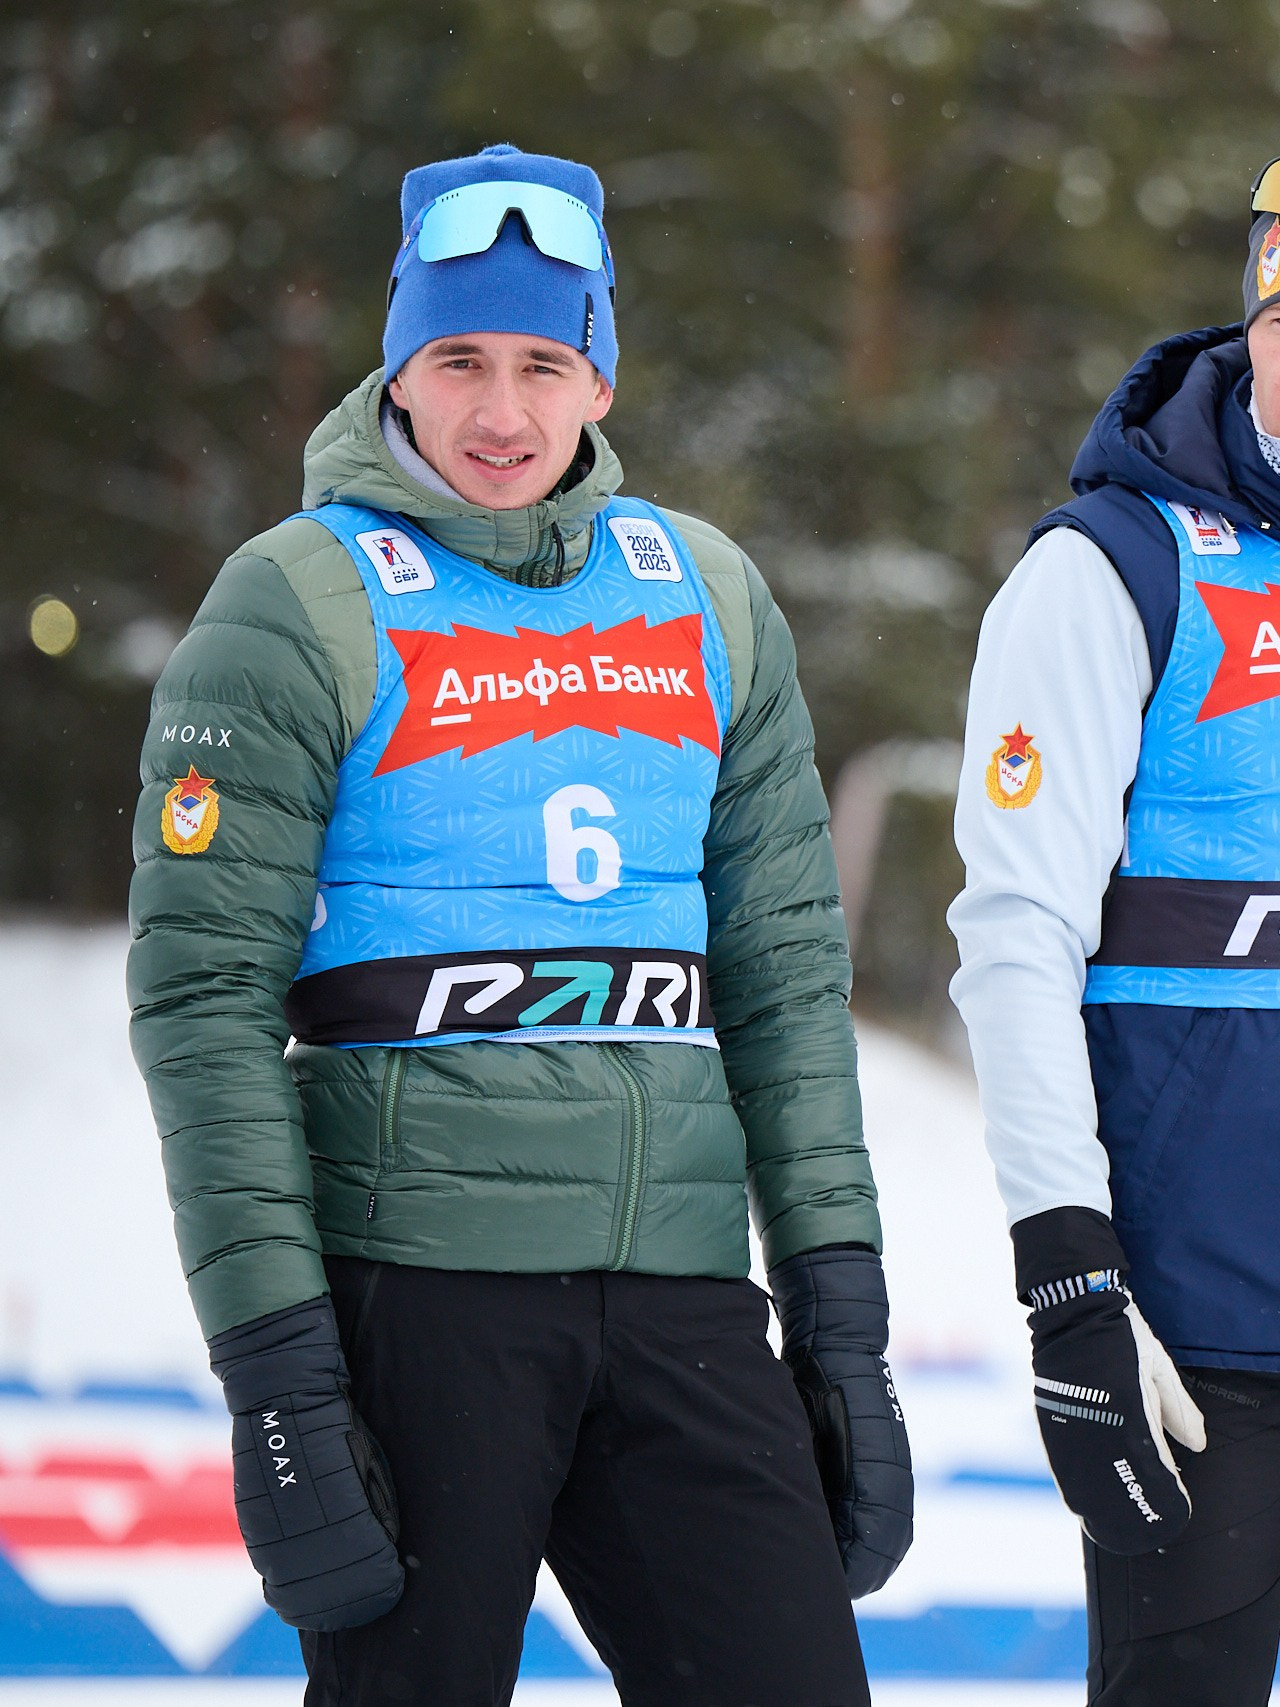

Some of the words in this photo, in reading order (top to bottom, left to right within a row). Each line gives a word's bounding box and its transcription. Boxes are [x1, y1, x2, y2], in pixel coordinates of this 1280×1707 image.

[586, 312, 595, 347] MOAX
[620, 523, 656, 536] СЕЗОН
[627, 535, 663, 553] 2024
[634, 552, 671, 572] 2025
[394, 572, 419, 584] СБР
[432, 657, 587, 709] Альфа
[590, 655, 696, 698] Банк
[161, 724, 233, 748] MOAX
[1001, 767, 1023, 787] ЦСКА
[175, 810, 199, 830] ЦСКА
[542, 783, 623, 903] 6
[414, 960, 701, 1036] PARI
[367, 1196, 376, 1219] MOAX
[1196, 1380, 1261, 1409] NORDSKI
[262, 1410, 297, 1488] MOAX
